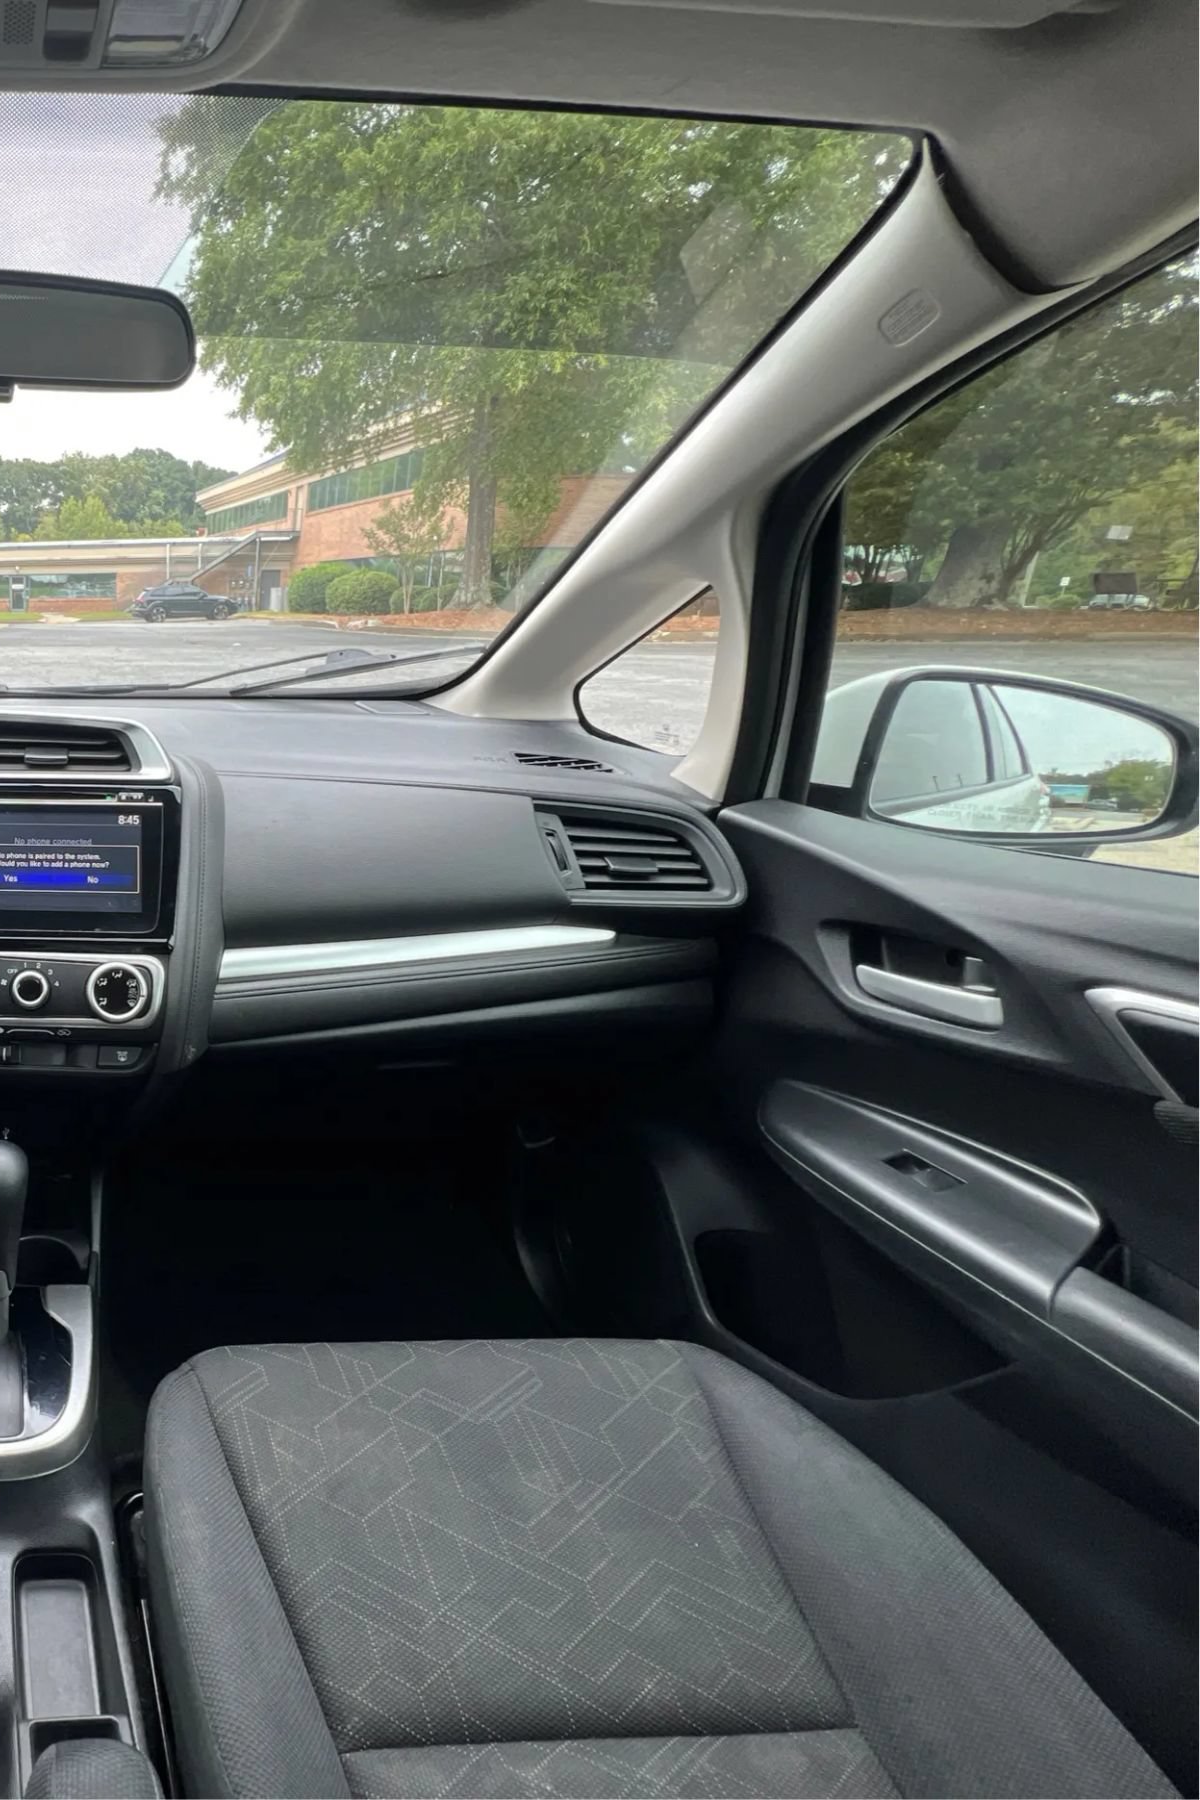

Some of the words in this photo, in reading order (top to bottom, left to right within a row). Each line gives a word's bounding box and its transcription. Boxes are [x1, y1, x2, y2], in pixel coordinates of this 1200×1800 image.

[117, 814, 140, 825] 8:45
[14, 837, 25, 845] No
[52, 838, 92, 846] connected
[69, 861, 91, 869] phone
[3, 874, 18, 882] Yes
[87, 875, 99, 883] No
